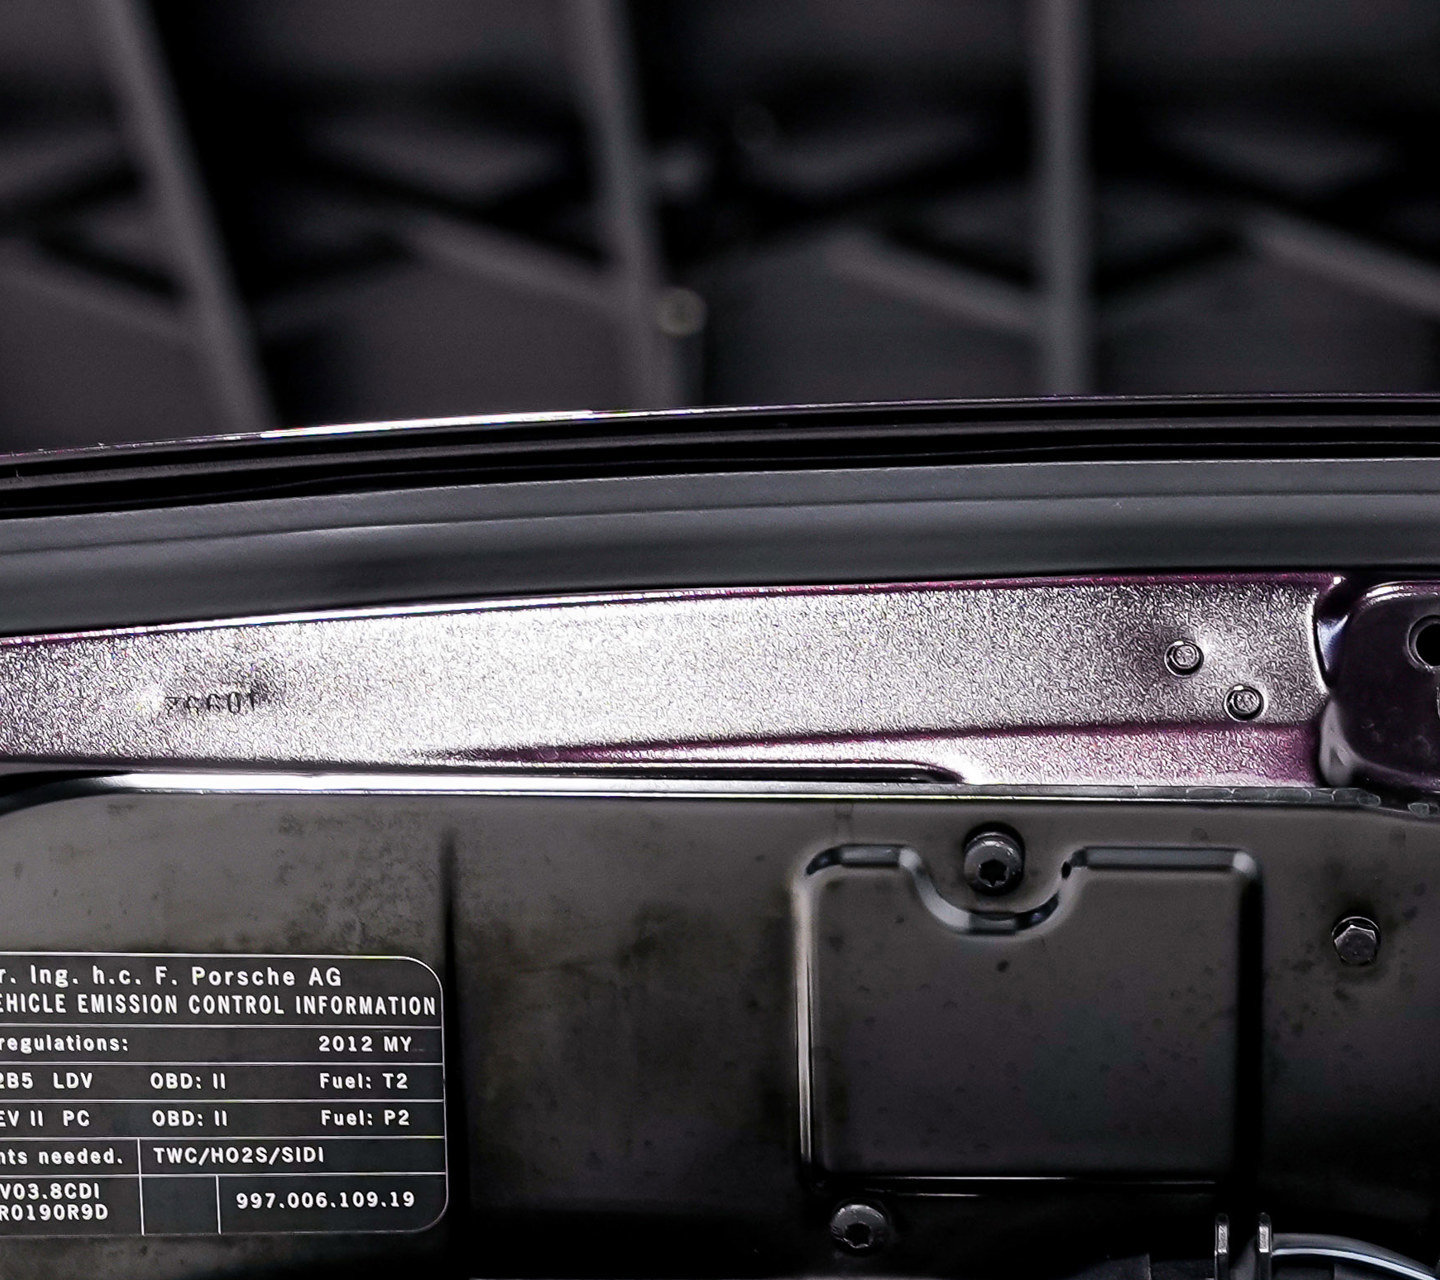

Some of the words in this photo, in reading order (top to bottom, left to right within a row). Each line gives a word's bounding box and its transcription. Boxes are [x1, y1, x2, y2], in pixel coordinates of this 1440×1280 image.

[31, 965, 78, 988] Ing.
[93, 965, 141, 985] h.c.
[156, 966, 177, 985] F.
[192, 967, 294, 985] Porsche
[309, 967, 341, 986] AG
[78, 994, 177, 1013] EMISSION
[189, 995, 284, 1014] CONTROL
[296, 996, 435, 1015] INFORMATION
[319, 1036, 372, 1051] 2012
[384, 1036, 411, 1052] MY
[53, 1072, 92, 1088] LDV
[151, 1073, 201, 1089] OBD:
[213, 1073, 225, 1089] II
[320, 1073, 371, 1089] Fuel:
[383, 1073, 407, 1088] T2
[31, 1110, 43, 1126] II
[63, 1110, 89, 1126] PC
[152, 1110, 203, 1126] OBD:
[215, 1111, 227, 1126] II
[322, 1110, 372, 1125] Fuel:
[384, 1110, 409, 1125] P2
[39, 1148, 122, 1164] needed.
[153, 1147, 323, 1165] TWC/HO2S/SIDI
[237, 1192, 414, 1209] 997.006.109.19
